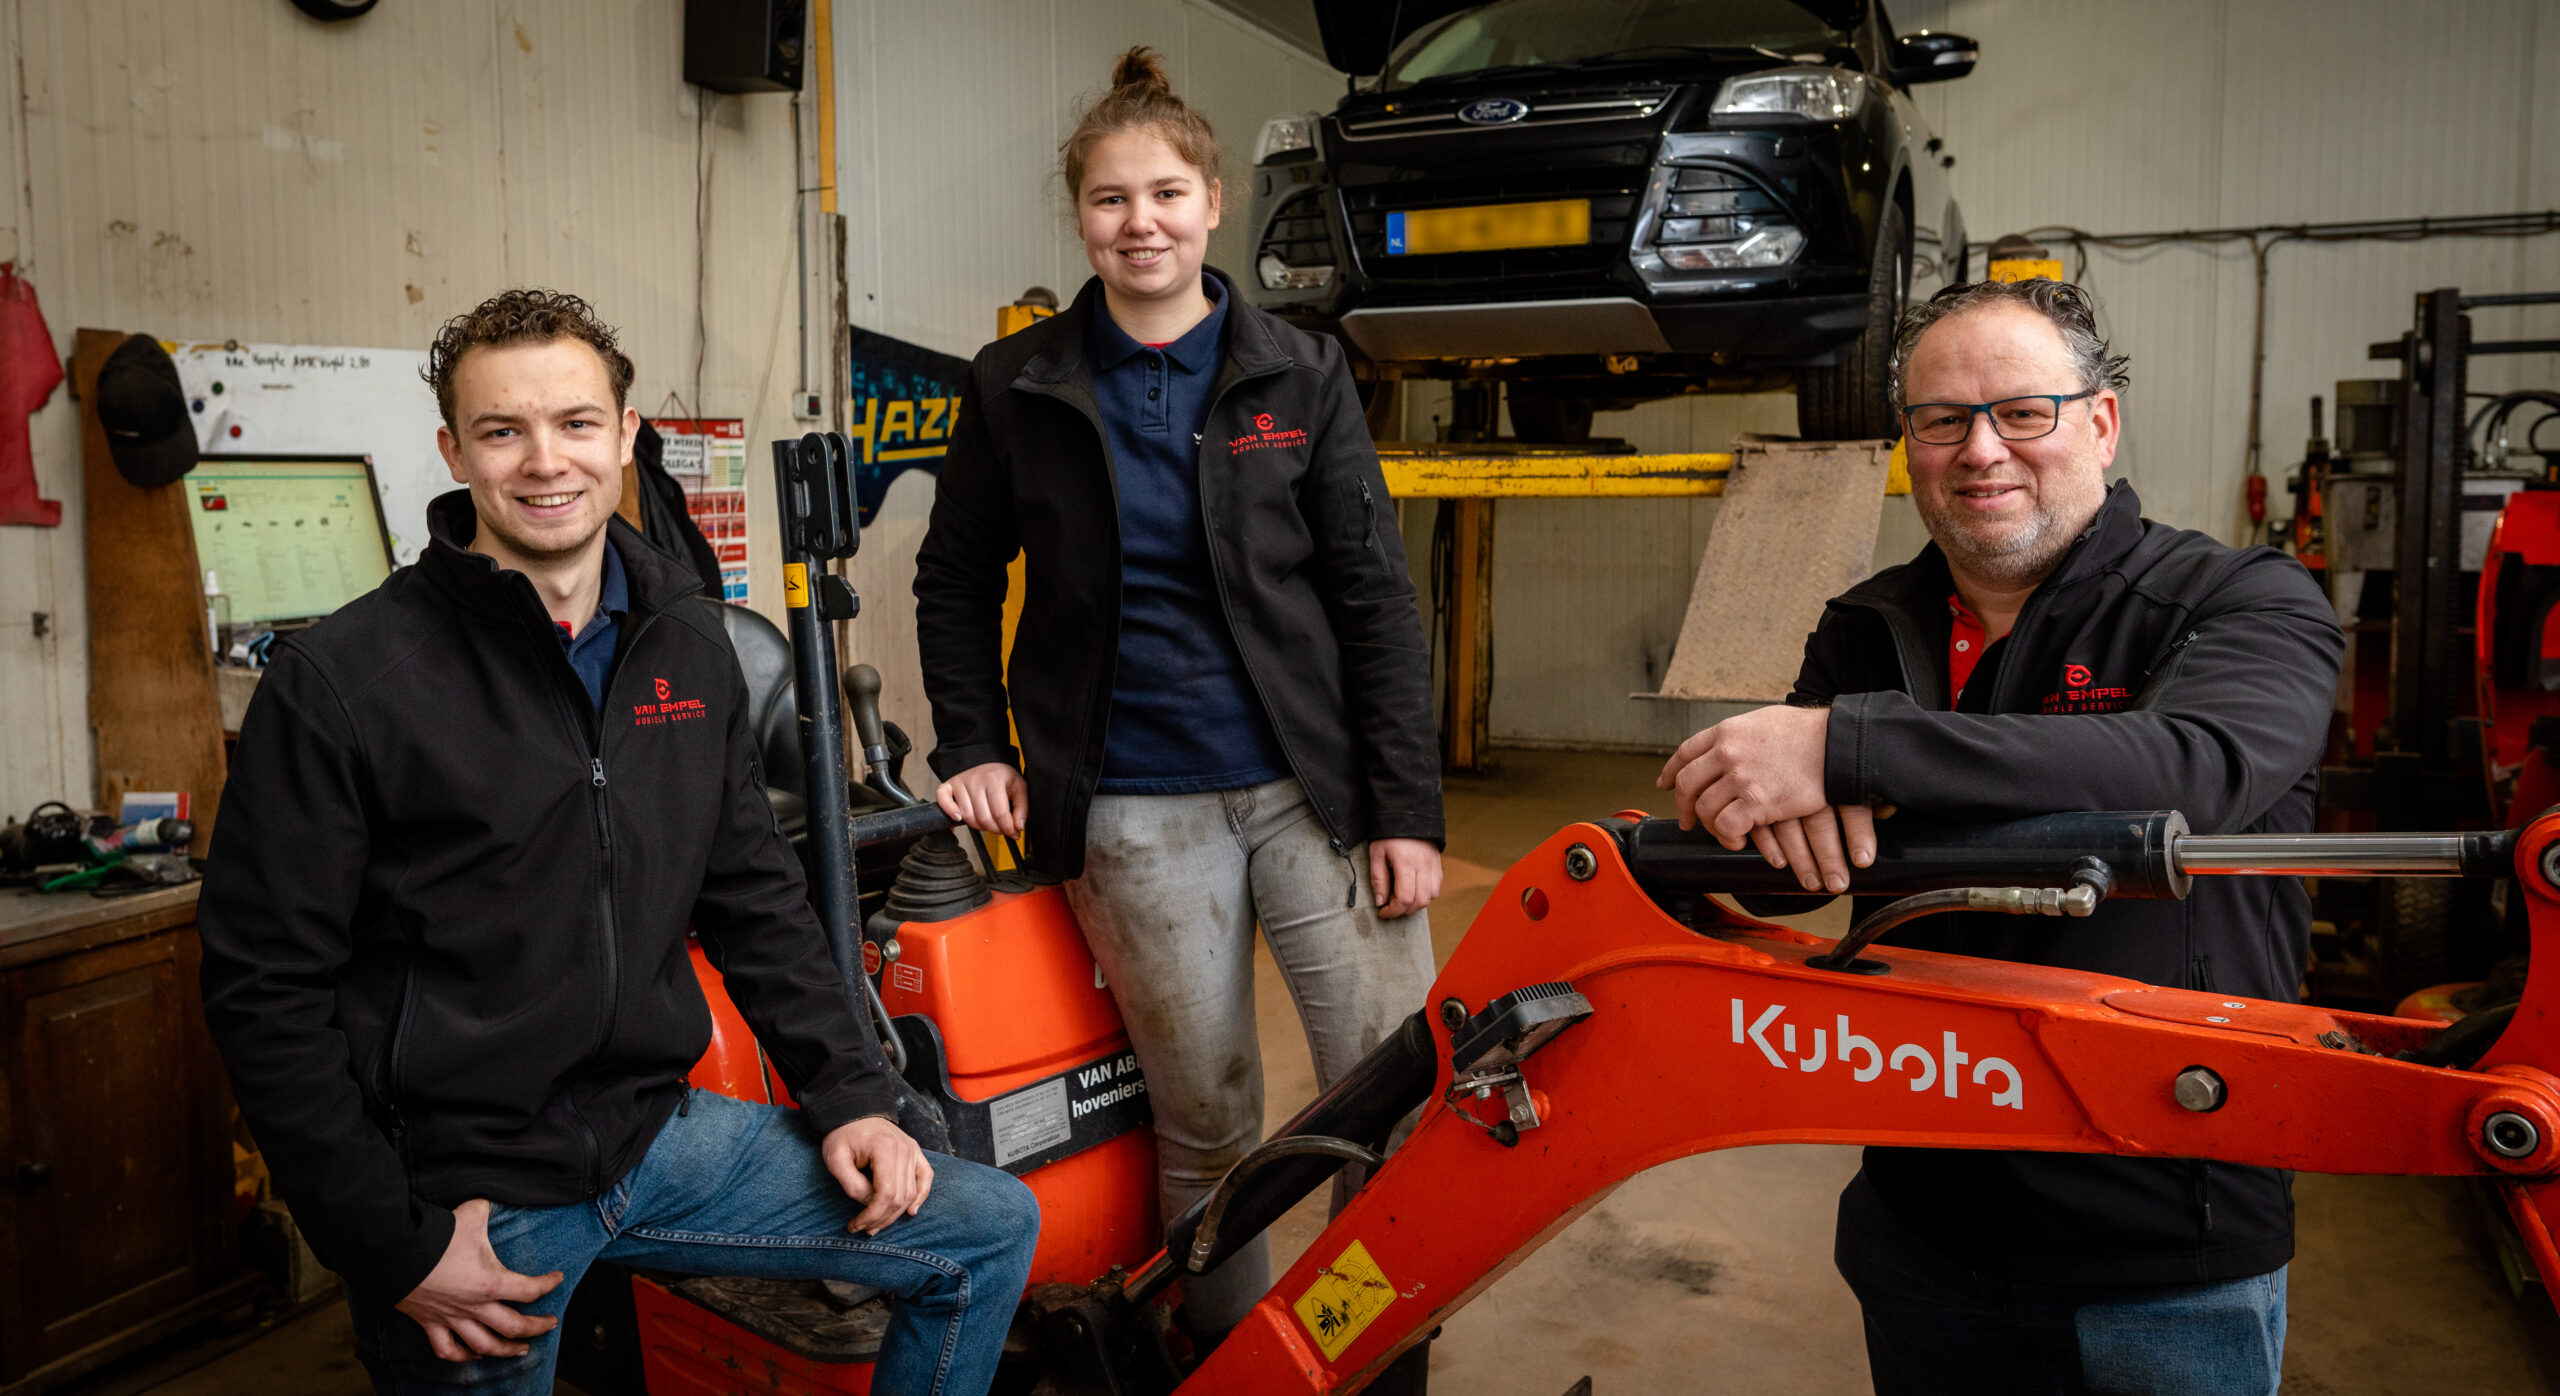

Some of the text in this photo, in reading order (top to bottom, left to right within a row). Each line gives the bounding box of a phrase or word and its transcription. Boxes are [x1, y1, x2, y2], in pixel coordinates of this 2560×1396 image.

[1472, 102, 1511, 119] Ford
[1390, 237, 1404, 248] NL
[1228, 428, 1308, 448] VAN EMPEL
[1233, 437, 1308, 455] MOBIELE SERVICE
[2065, 687, 2133, 701] EMPEL
[634, 699, 706, 716] VAN EMPEL
[636, 709, 706, 726] MOBIELE SERVICE
[1731, 997, 2024, 1110] Kubota
[1078, 1062, 1112, 1089] VAN
[1071, 1079, 1146, 1119] hoveniers
